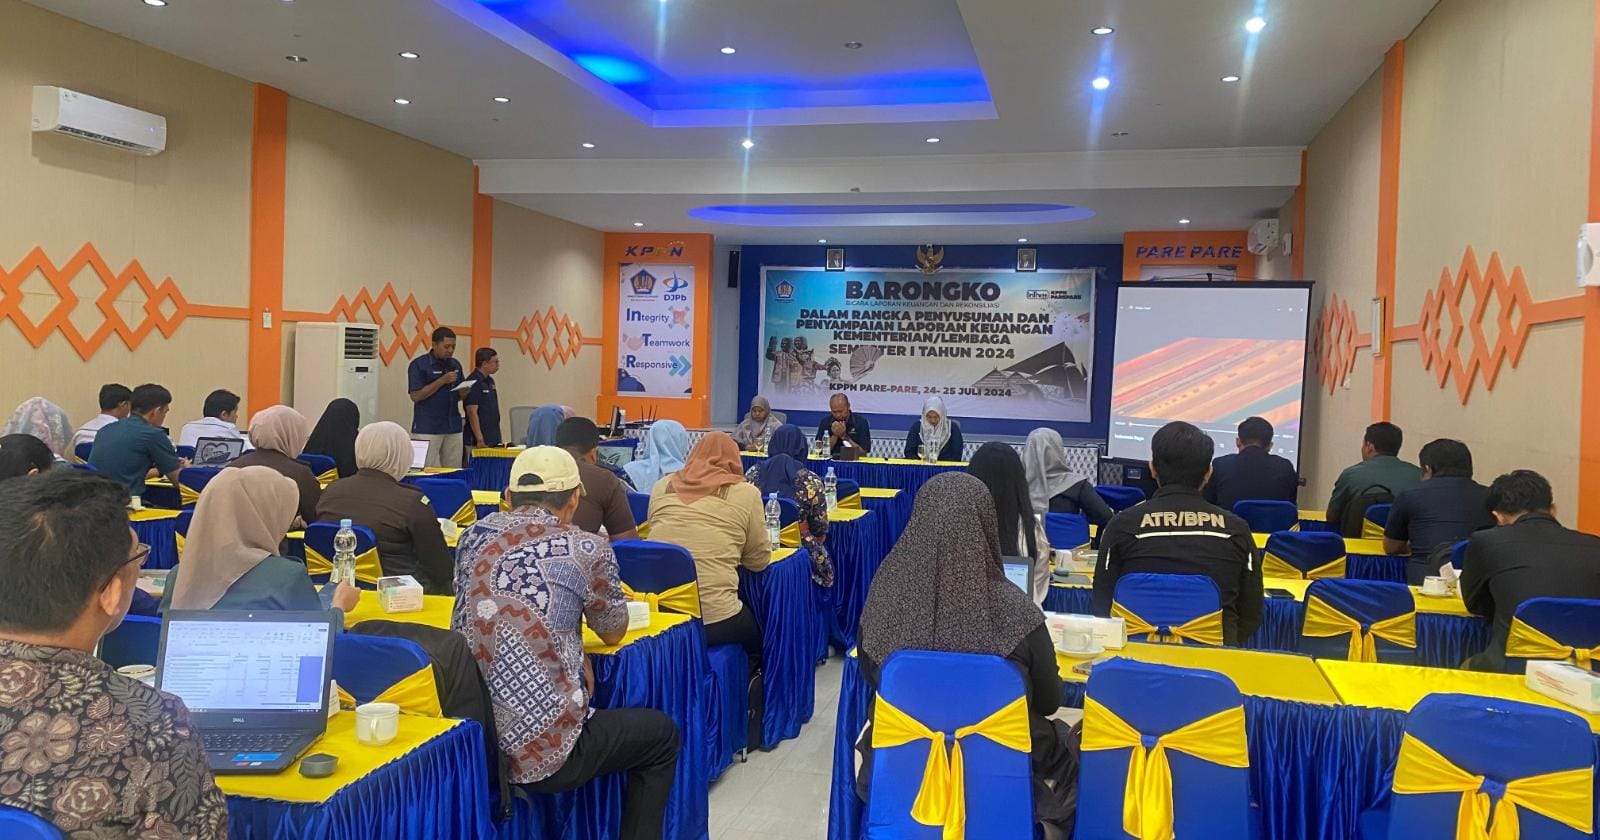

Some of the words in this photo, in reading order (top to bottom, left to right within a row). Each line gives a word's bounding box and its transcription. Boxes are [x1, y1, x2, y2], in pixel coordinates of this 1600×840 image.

[1136, 246, 1186, 258] PARE
[1190, 246, 1243, 258] PARE
[845, 281, 1001, 301] BARONGKO
[626, 308, 670, 323] Integrity
[800, 309, 848, 319] DALAM
[851, 310, 911, 320] RANGKA
[915, 311, 1013, 323] PENYUSUNAN
[1017, 313, 1050, 323] DAN
[796, 319, 894, 331] PENYAMPAIAN
[897, 322, 966, 332] LAPORAN
[970, 323, 1053, 334] KEUANGAN
[642, 333, 690, 347] Teamwork
[833, 331, 1011, 344] KEMENTERIAN/LEMBAGA
[829, 344, 909, 356] SEMTER
[910, 346, 915, 356] I
[918, 346, 972, 357] TAHUN
[975, 348, 1015, 359] 2024
[626, 355, 678, 369] Responsive
[829, 383, 857, 391] KPPN
[860, 384, 921, 395] PARE-PARE,
[943, 387, 956, 395] 25
[958, 387, 982, 396] JULI
[984, 388, 1012, 397] 2024
[1140, 511, 1226, 529] ATR/BPN
